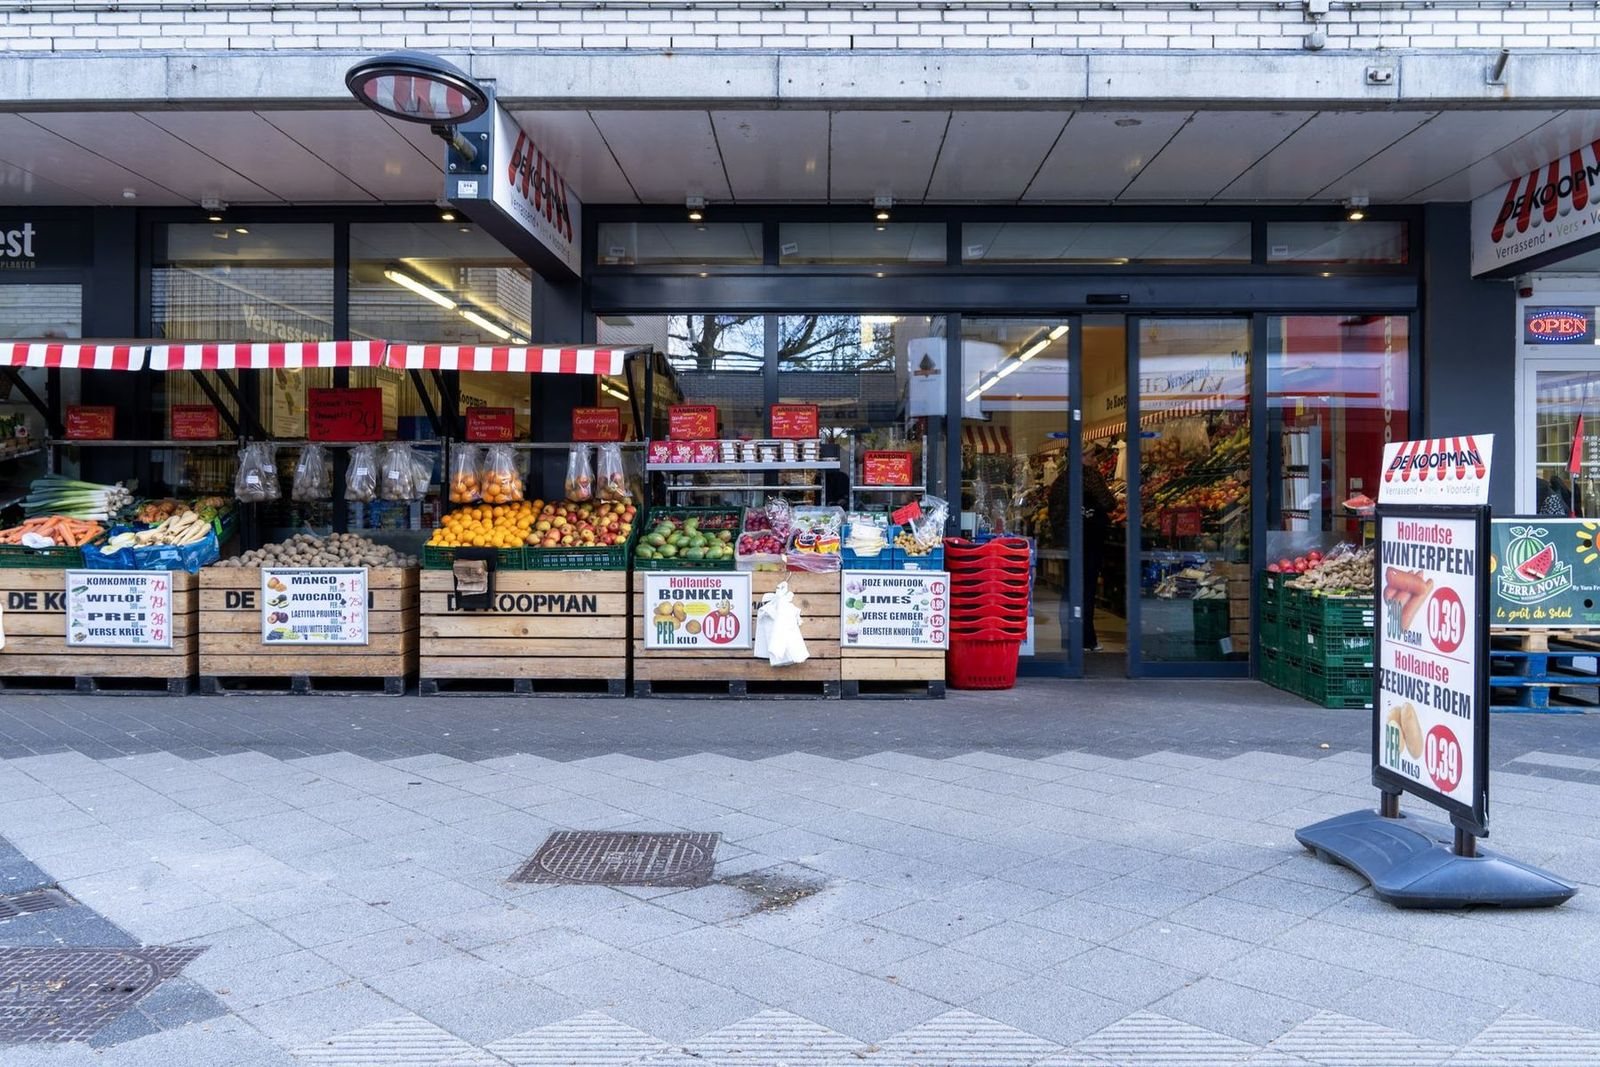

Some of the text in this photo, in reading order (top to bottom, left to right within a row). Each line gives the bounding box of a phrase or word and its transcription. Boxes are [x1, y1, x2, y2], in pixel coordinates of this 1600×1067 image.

[1499, 195, 1526, 223] DE
[1496, 230, 1546, 259] Verrassend
[1556, 221, 1579, 238] Vers
[1530, 319, 1587, 333] OPEN
[1390, 450, 1482, 470] DE KOOPMAN
[1446, 483, 1481, 497] Voordelig
[1397, 521, 1452, 545] Hollandse
[1382, 541, 1474, 576] WINTERPEEN
[86, 577, 147, 586] KOMKOMMER
[291, 576, 337, 585] MANGO
[670, 577, 722, 588] Hollandse
[862, 579, 924, 587] ROZE KNOFLOOK
[1502, 582, 1536, 596] TERRA
[1537, 575, 1568, 595] NOVA
[86, 594, 143, 603] WITLOF
[292, 593, 342, 601] AVOCADO
[659, 589, 733, 600] BONKEN
[907, 588, 915, 596] 2
[8, 592, 38, 610] DE
[225, 591, 255, 609] DE
[862, 596, 911, 604] LIMES
[88, 612, 146, 621] PREI
[862, 612, 924, 621] VERSE GEMBER
[1549, 606, 1573, 619] Soleil
[705, 615, 736, 641] 0,49
[1429, 597, 1461, 645] 0,39
[88, 628, 144, 637] VERSE KRIEL
[657, 621, 674, 644] PER
[863, 628, 923, 636] BEEMSTER KNOFLOOK
[1395, 650, 1449, 684] Hollandse
[1433, 685, 1471, 720] ROEM
[1385, 723, 1421, 780] PER KILO
[1427, 732, 1458, 785] 0,39
